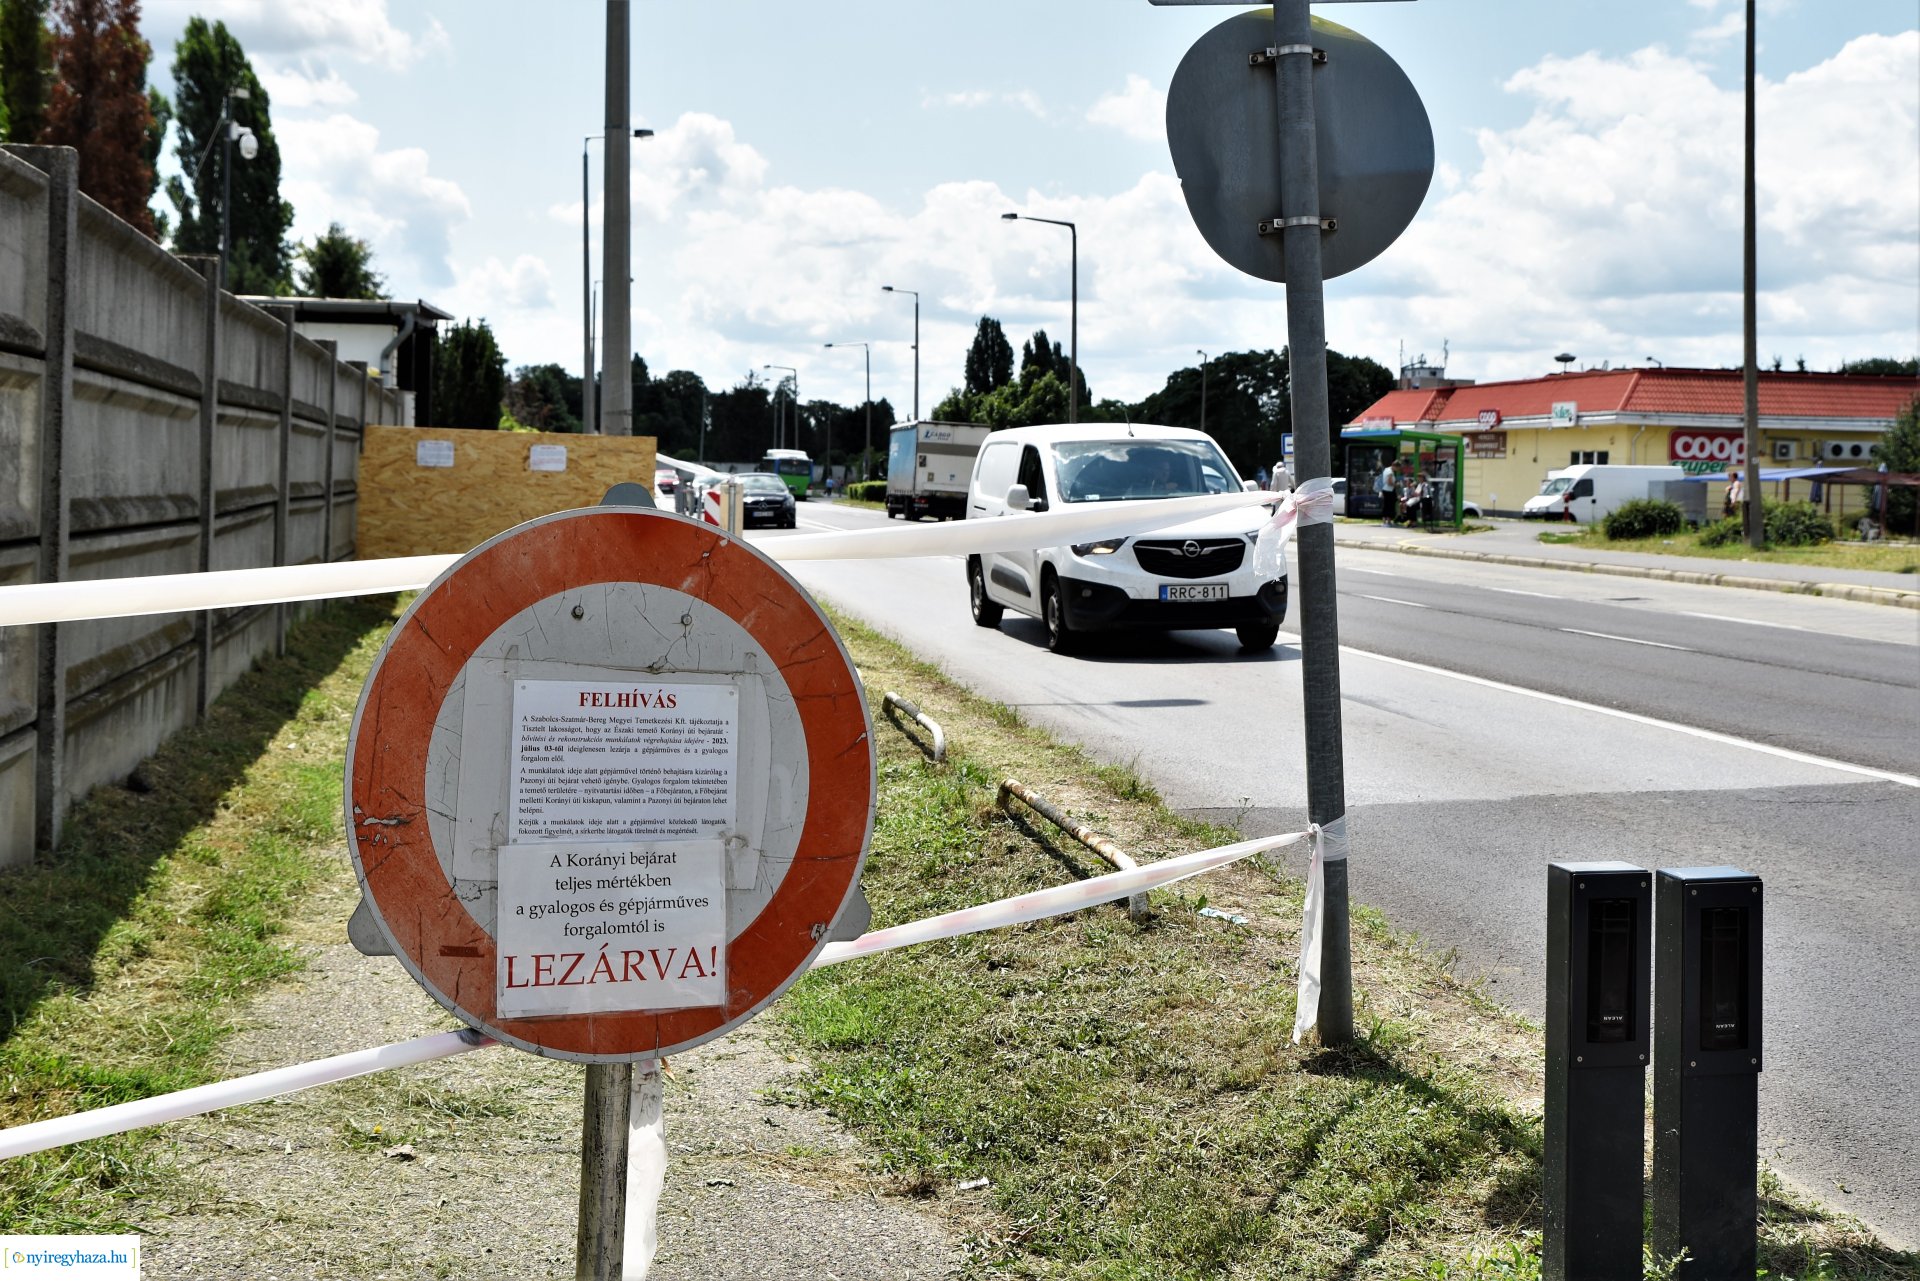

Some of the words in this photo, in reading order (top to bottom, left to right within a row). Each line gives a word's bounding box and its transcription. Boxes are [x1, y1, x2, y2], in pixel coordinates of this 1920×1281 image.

[1170, 587, 1224, 598] RRC-811
[578, 688, 677, 708] FELHÍVÁS
[530, 715, 607, 724] Szabolcs-Szatmár-Bereg
[609, 716, 633, 725] Megyei
[634, 716, 672, 724] Temetkezési
[689, 718, 723, 726] tájékoztatja
[548, 725, 583, 734] lakosságot,
[585, 726, 601, 734] hogy
[614, 724, 634, 733] Északi
[660, 727, 685, 736] Korányi
[698, 728, 724, 736] bejáratát
[520, 744, 540, 753] július
[567, 745, 606, 754] ideiglenesen
[610, 745, 630, 754] lezárja
[684, 746, 690, 754] és
[701, 746, 728, 756] gyalogos
[520, 777, 546, 785] Pazonyi
[558, 777, 579, 786] bejárat
[604, 778, 630, 786] igénybe.
[632, 778, 660, 786] Gyalogos
[662, 778, 690, 786] forgalom
[545, 797, 571, 805] Korányi
[582, 797, 612, 805] kiskapun,
[648, 797, 672, 805] Pazonyi
[683, 797, 711, 806] bejáraton
[518, 806, 544, 815] belépni.
[550, 854, 562, 868] A
[566, 852, 626, 870] Korányi
[630, 852, 677, 868] bejárat
[555, 876, 592, 894] teljes
[596, 874, 672, 890] mértékben
[516, 904, 524, 915] a
[529, 900, 595, 919] gyalogos
[600, 899, 614, 912] és
[618, 896, 709, 915] gépjárműves
[563, 920, 650, 940] forgalomtól
[653, 920, 665, 932] is
[504, 942, 717, 988] LEZÁRVA!
